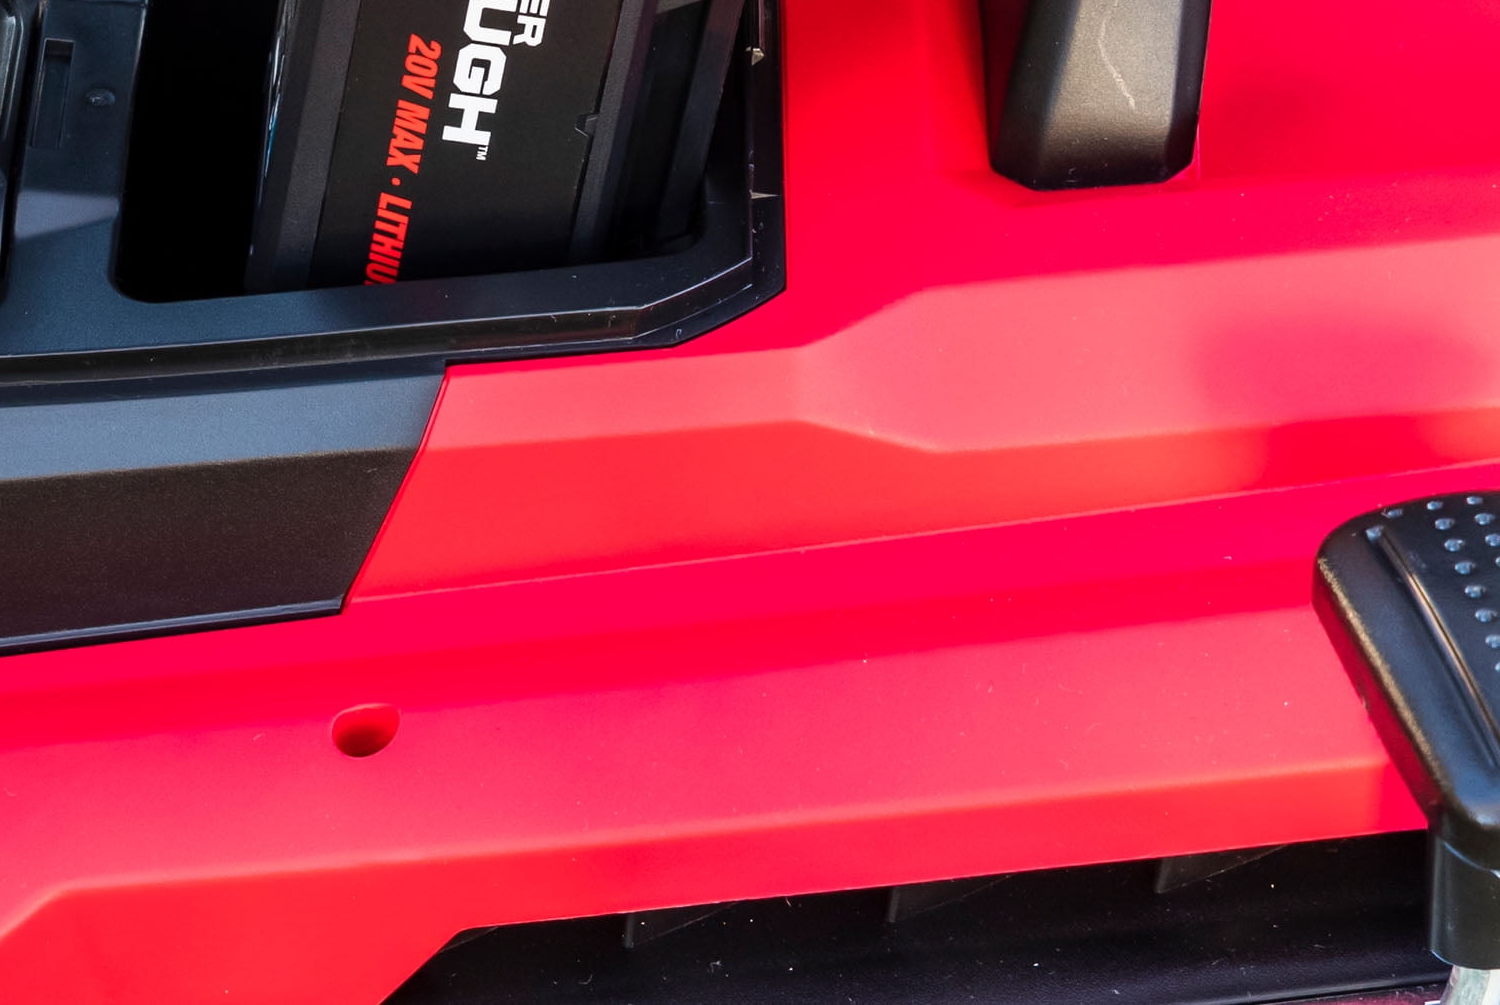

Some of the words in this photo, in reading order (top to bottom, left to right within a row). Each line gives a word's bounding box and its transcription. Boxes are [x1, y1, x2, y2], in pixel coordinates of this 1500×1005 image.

[401, 33, 442, 100] 20V
[386, 99, 431, 175] MAX
[364, 192, 413, 285] LITHIU
